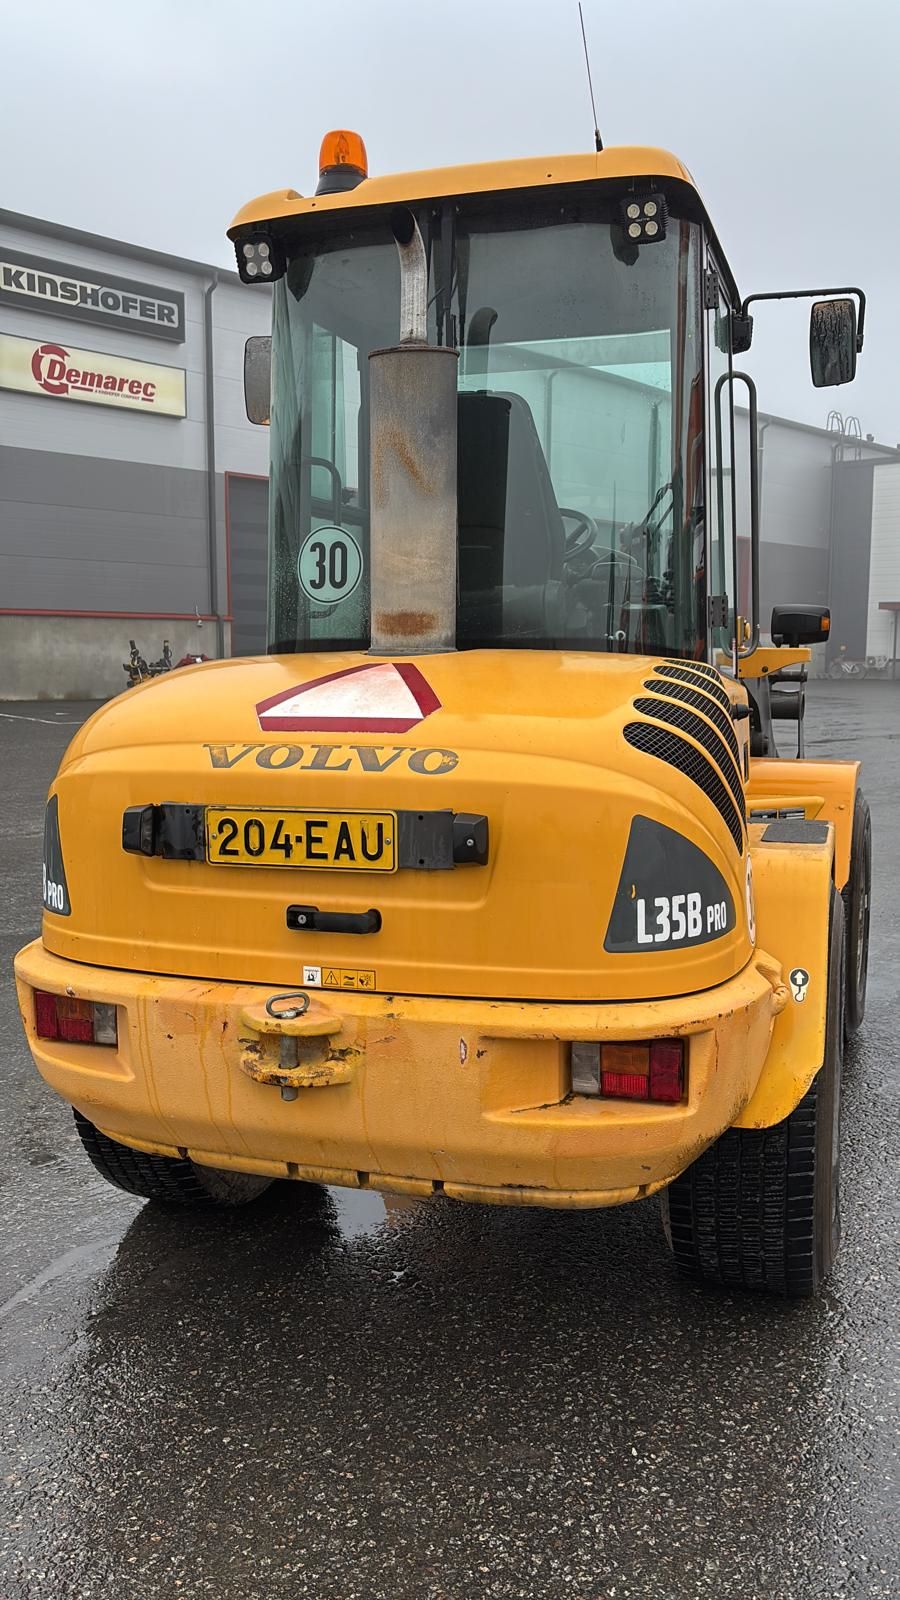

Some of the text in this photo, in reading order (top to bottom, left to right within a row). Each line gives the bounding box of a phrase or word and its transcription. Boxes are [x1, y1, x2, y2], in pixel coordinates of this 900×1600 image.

[47, 359, 156, 397] Demarec
[310, 541, 347, 589] 30
[203, 744, 459, 775] VOLVO
[217, 818, 384, 861] 204-EAU
[47, 880, 64, 910] PRO
[637, 892, 702, 943] L35B
[706, 901, 727, 933] PRO
